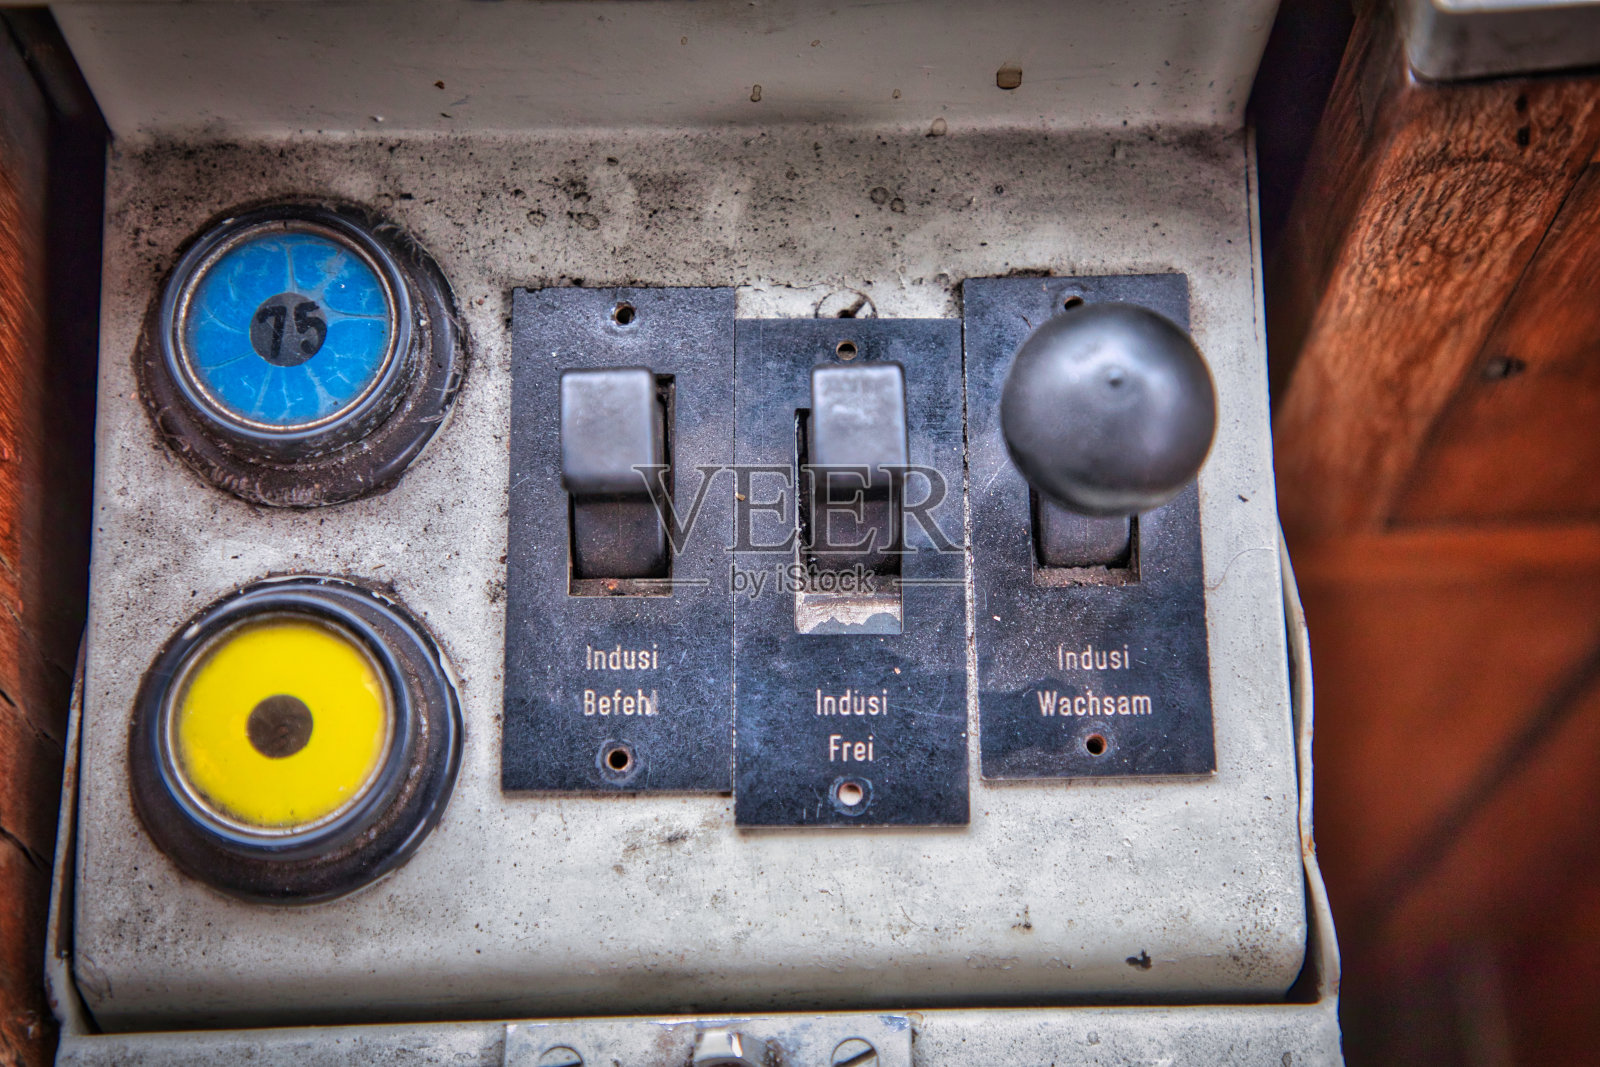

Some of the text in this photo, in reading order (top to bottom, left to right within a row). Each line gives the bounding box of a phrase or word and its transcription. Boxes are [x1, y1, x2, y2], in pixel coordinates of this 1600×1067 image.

[586, 643, 659, 670] Indusi
[1058, 643, 1130, 670] Indusi
[584, 688, 659, 716] Befehl
[816, 688, 888, 716] Indusi
[1037, 689, 1153, 716] Wachsam
[829, 734, 874, 762] Frei
